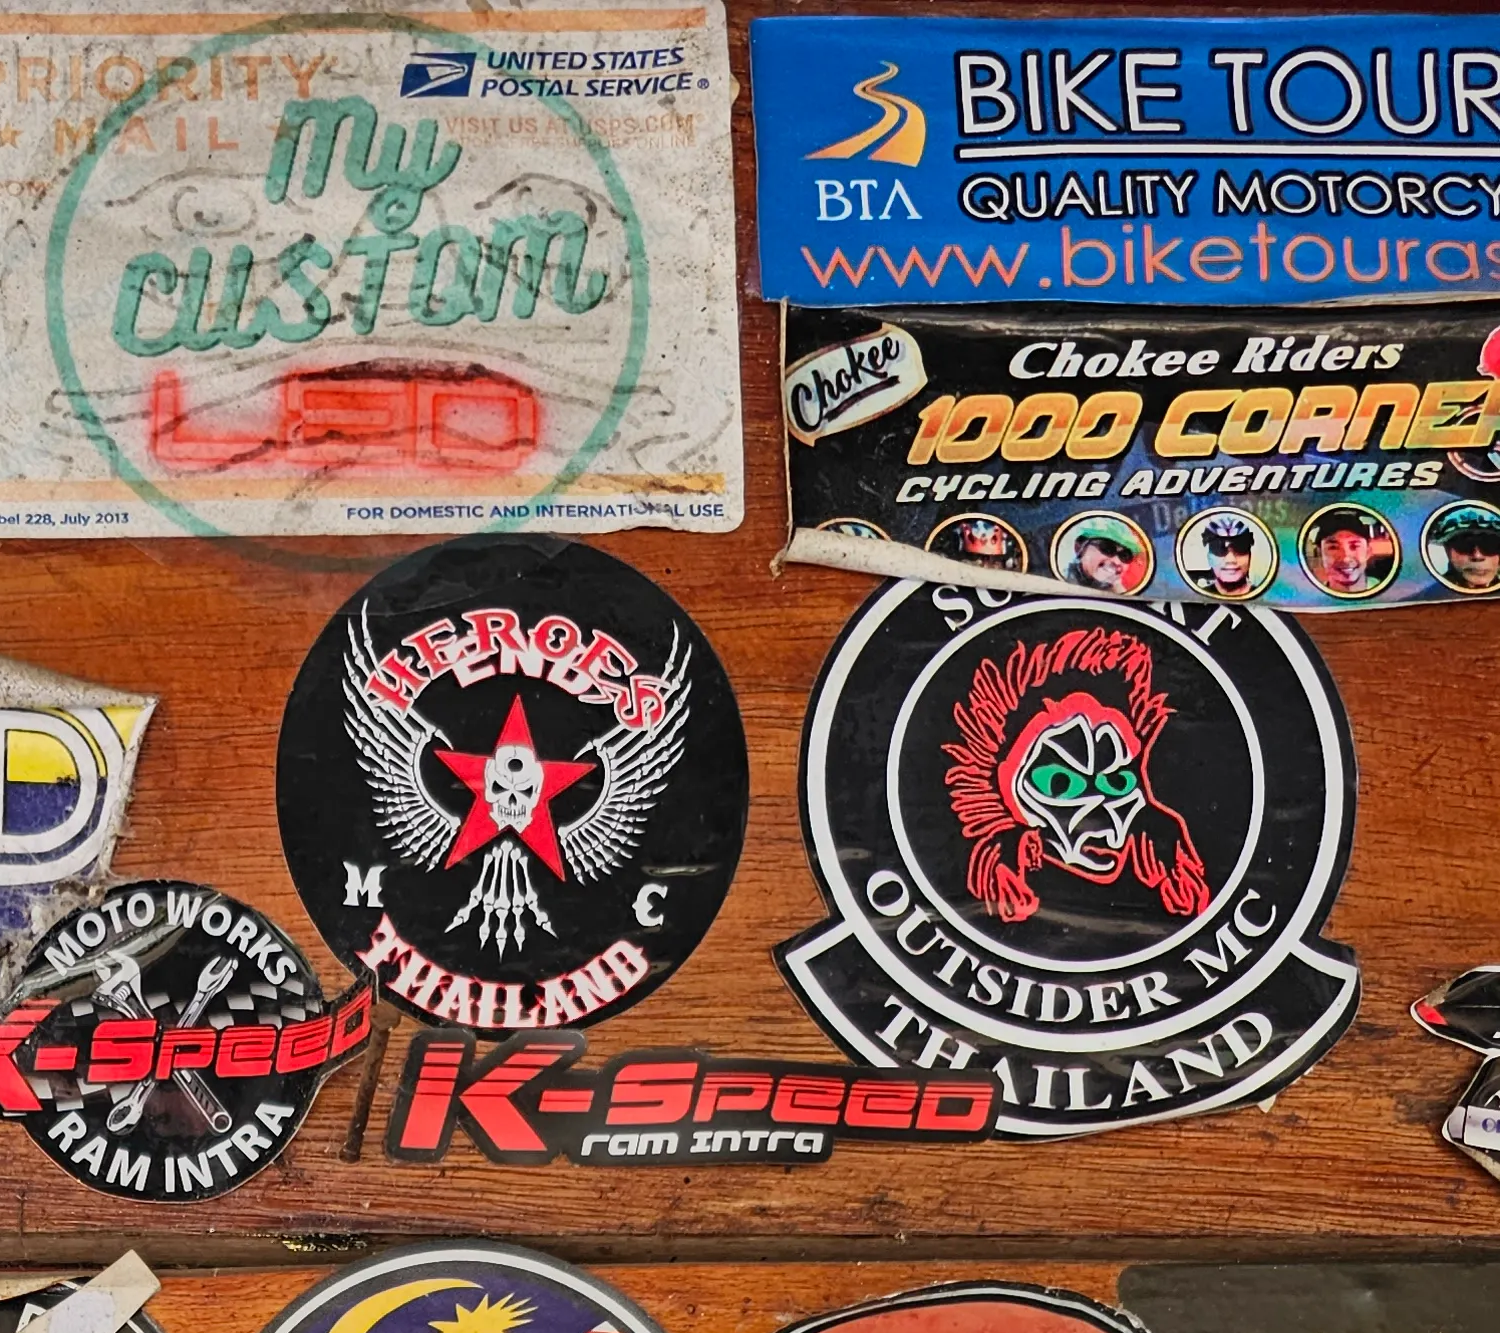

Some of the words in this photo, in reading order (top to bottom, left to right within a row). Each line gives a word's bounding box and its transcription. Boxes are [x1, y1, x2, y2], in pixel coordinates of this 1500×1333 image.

[481, 78, 581, 98] POSTAL
[584, 72, 694, 97] SERVICE
[487, 51, 588, 71] UNITED
[591, 47, 685, 70] STATES
[956, 50, 1182, 136] BIKE
[53, 116, 240, 156] MAIL
[509, 116, 538, 134] US
[962, 174, 1196, 221] QUALITY
[789, 333, 903, 430] Chokee
[1008, 340, 1220, 380] Chokee
[1232, 336, 1403, 375] Riders
[906, 390, 1145, 467] 1000
[896, 467, 1107, 503] CYCLING
[1121, 461, 1445, 499] ADVENTURES
[25, 513, 56, 529] 228,
[59, 512, 93, 530] July
[95, 511, 130, 526] 2013
[346, 505, 386, 520] FOR
[389, 503, 485, 519] DOMESTIC
[489, 503, 530, 518] AND
[689, 503, 725, 517] USE
[365, 608, 669, 730] HEROES
[343, 861, 385, 908] M
[631, 883, 668, 928] C
[45, 893, 157, 977] MOTO
[166, 890, 298, 988] WORKS
[866, 869, 1180, 1024] OUTSIDER
[1184, 888, 1278, 989] MC
[355, 912, 650, 1030] THAILAND
[49, 1101, 150, 1193] RAM
[164, 1099, 296, 1194] INTRA
